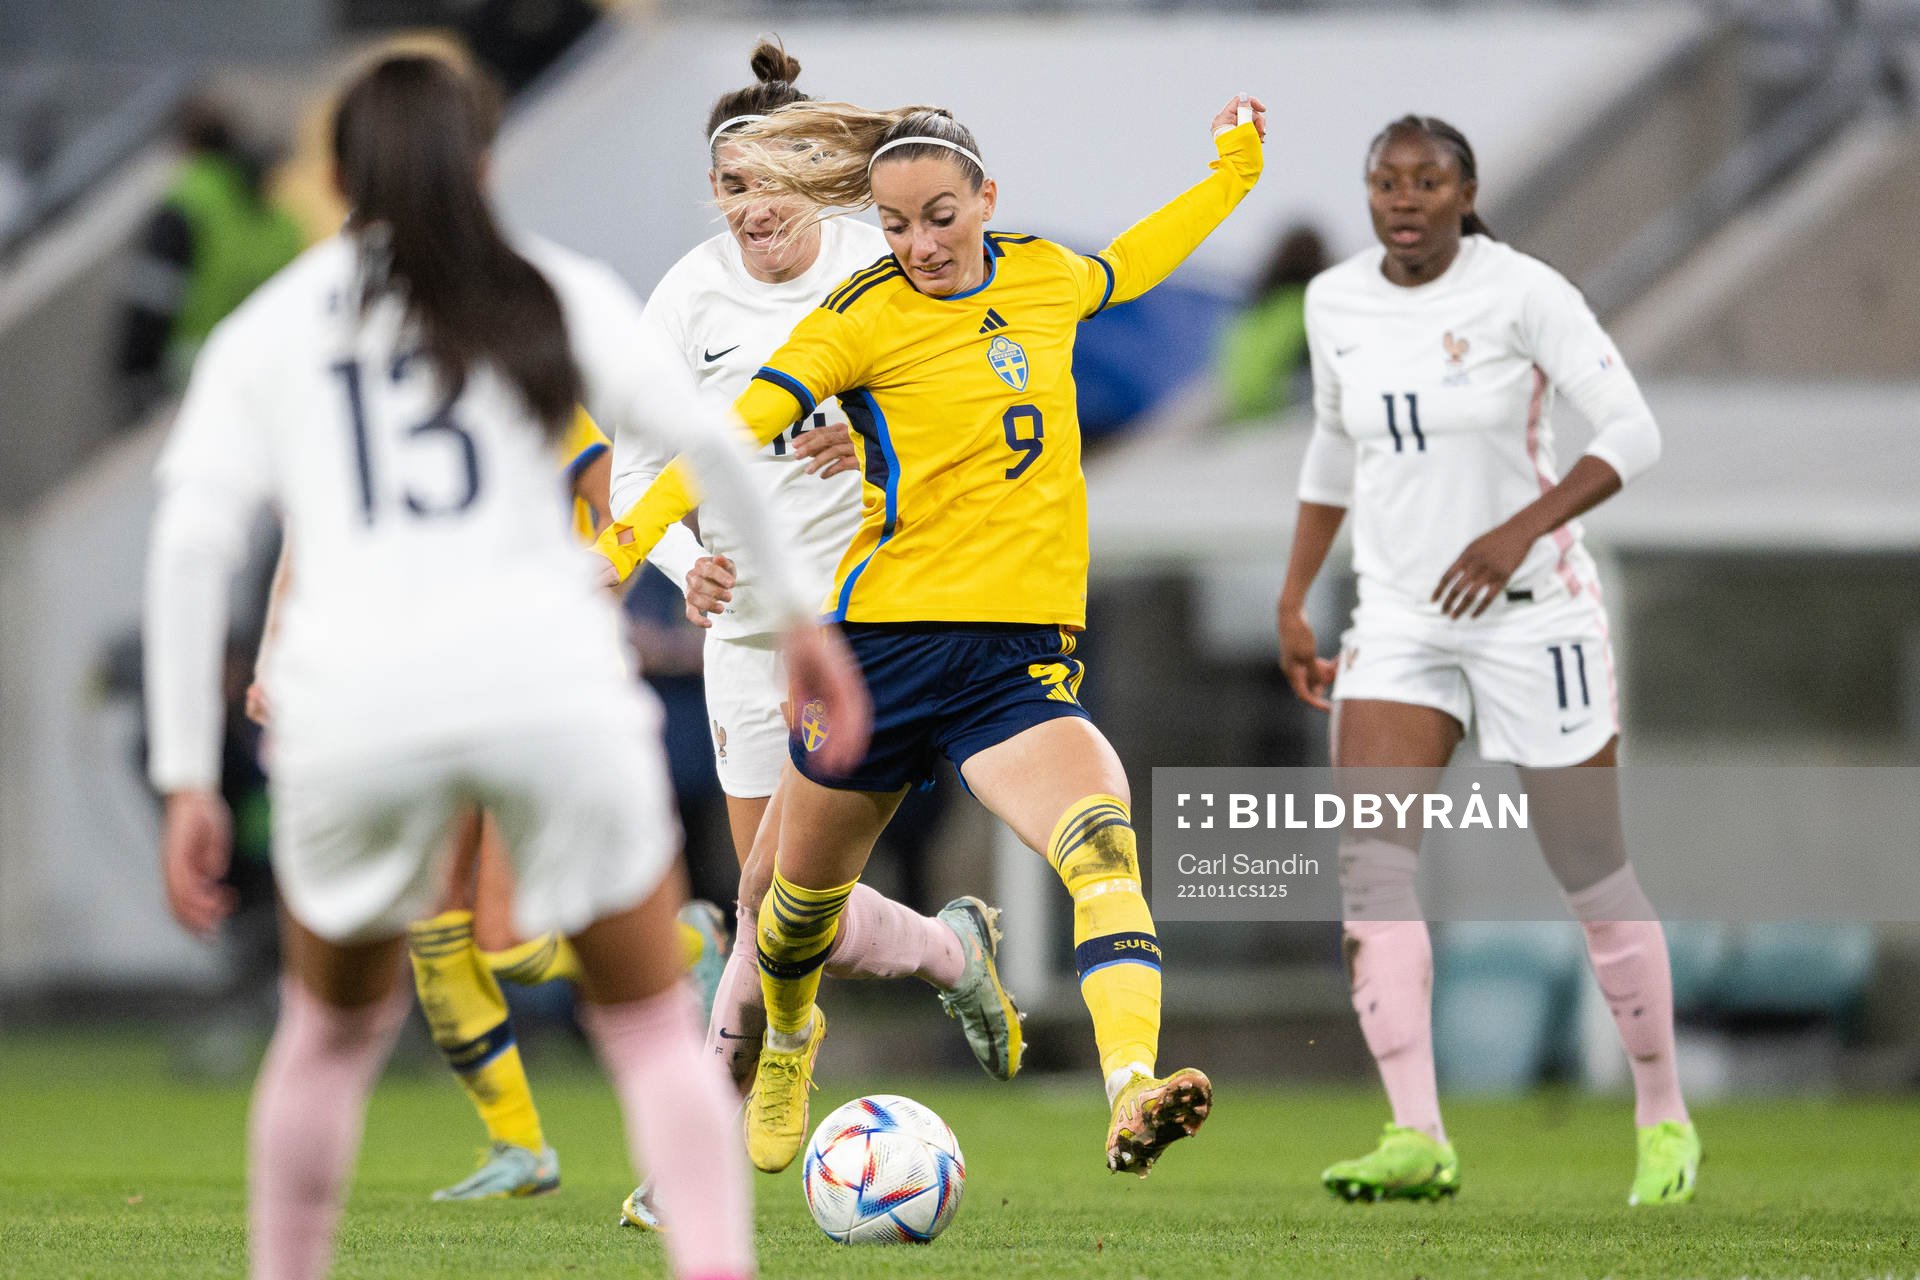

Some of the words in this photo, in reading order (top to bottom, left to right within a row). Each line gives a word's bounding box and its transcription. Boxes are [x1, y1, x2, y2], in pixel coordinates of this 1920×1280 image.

[330, 347, 479, 529] 13
[1002, 404, 1044, 480] 9
[1382, 394, 1425, 452] 11
[1547, 644, 1590, 709] 11
